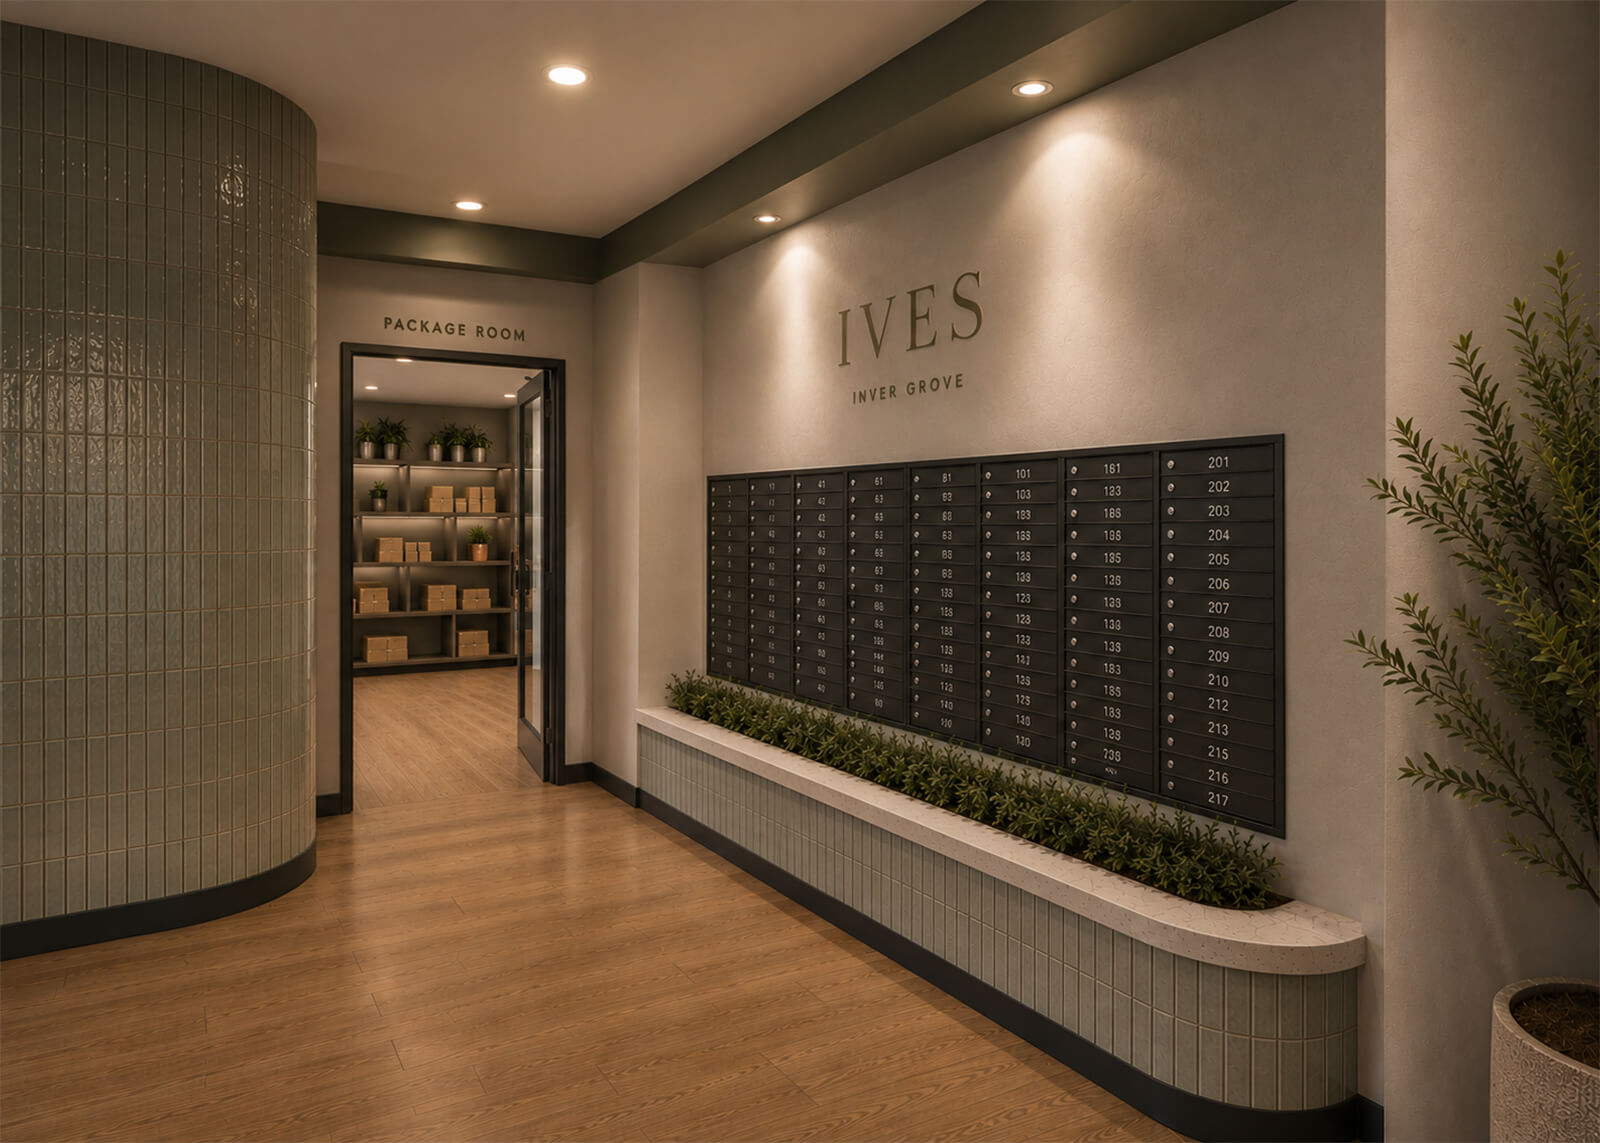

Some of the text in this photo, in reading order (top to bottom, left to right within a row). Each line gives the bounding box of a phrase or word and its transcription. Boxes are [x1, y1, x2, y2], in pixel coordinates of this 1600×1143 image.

[838, 271, 983, 367] IVES
[384, 316, 525, 342] PACKAGE ROOM
[852, 373, 963, 405] INVER GROVE
[1208, 455, 1229, 469] 201
[942, 472, 952, 484] 81
[1015, 468, 1031, 479] 101
[1208, 479, 1230, 493] 202
[1015, 488, 1032, 500] 103
[1208, 504, 1230, 517] 203
[1207, 528, 1231, 542] 204
[1207, 552, 1230, 566] 205
[1207, 577, 1230, 591] 206
[1208, 600, 1230, 615] 207
[1207, 625, 1230, 639] 208
[1207, 649, 1230, 664] 209
[1207, 673, 1229, 688] 210
[1207, 696, 1229, 712] 212
[1207, 721, 1229, 737] 213
[1207, 744, 1229, 761] 215
[1208, 768, 1229, 785] 216
[1208, 791, 1229, 807] 217
